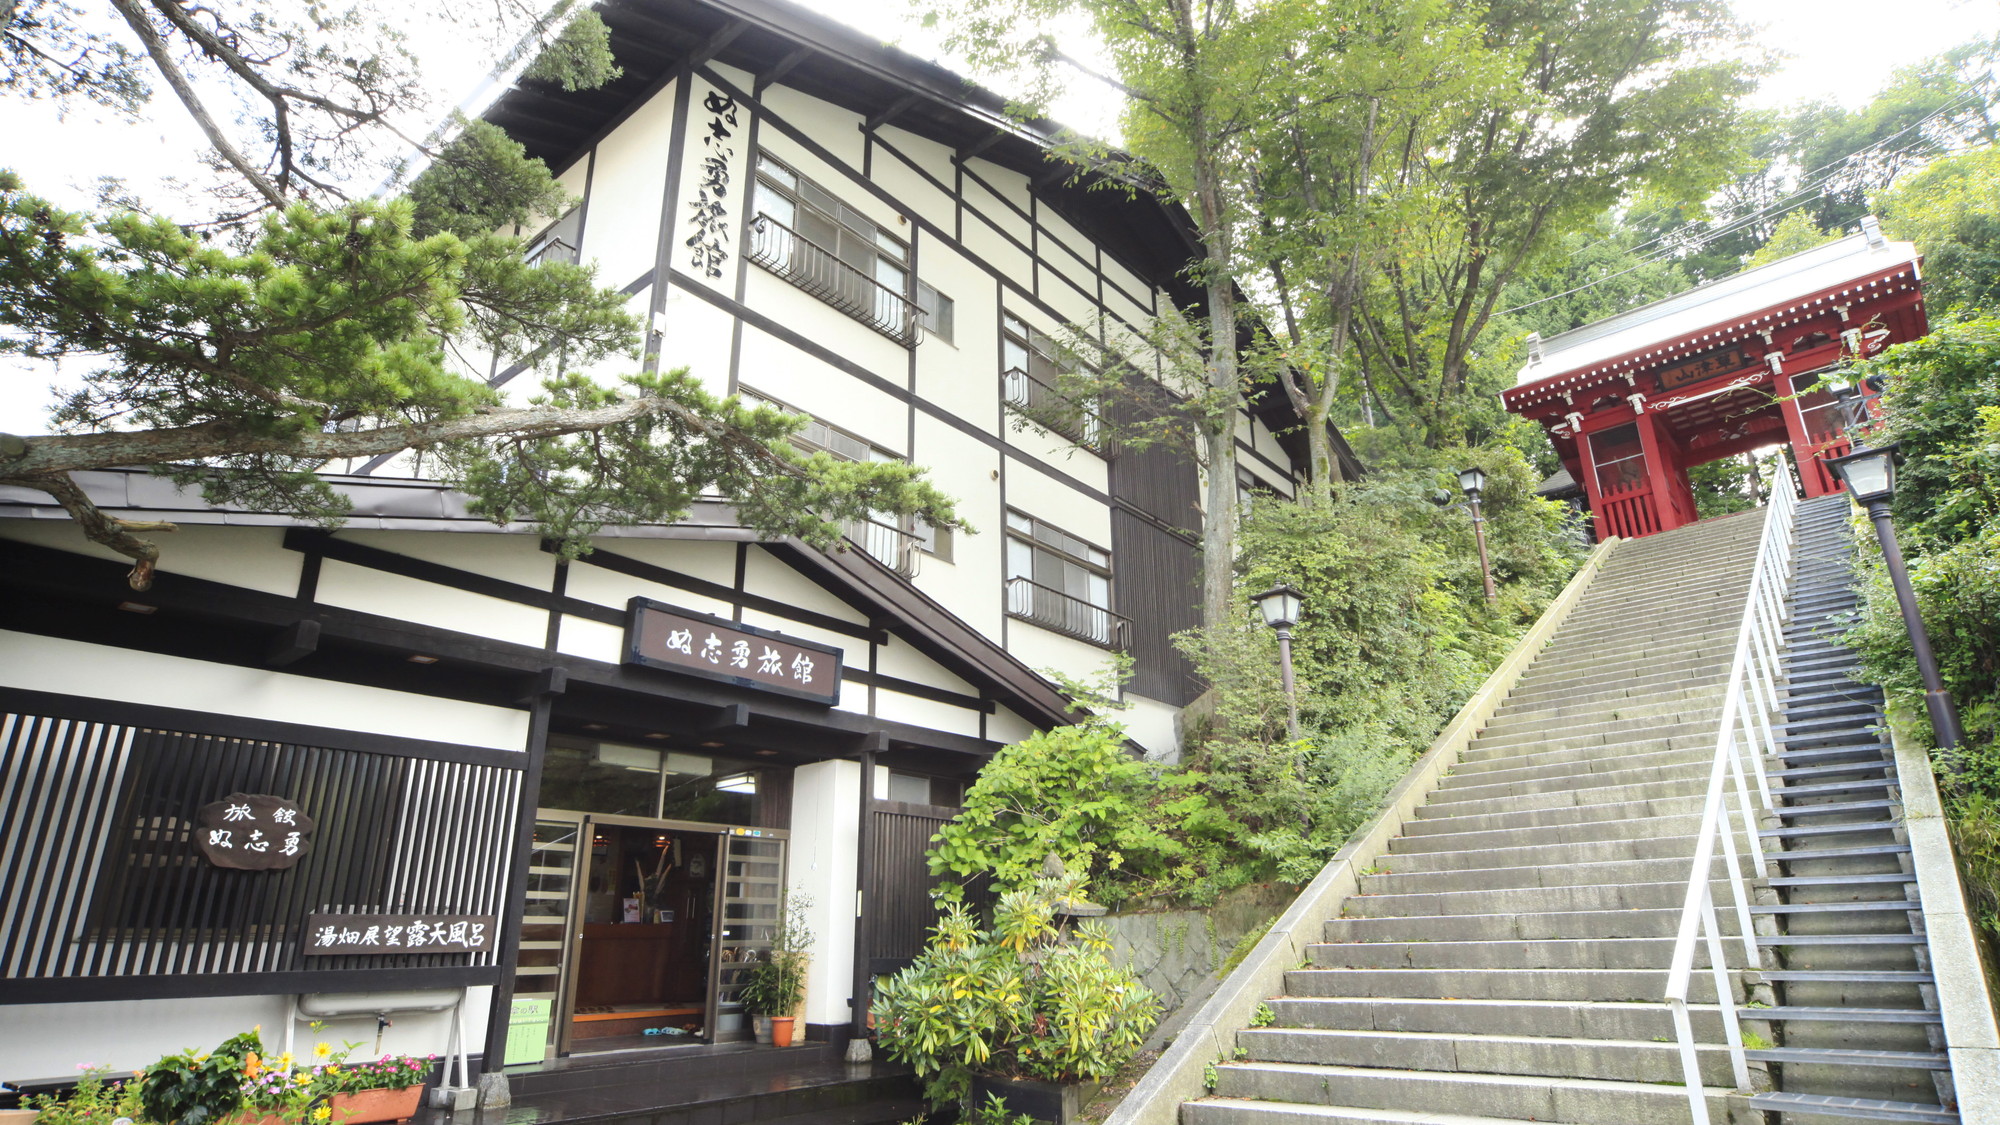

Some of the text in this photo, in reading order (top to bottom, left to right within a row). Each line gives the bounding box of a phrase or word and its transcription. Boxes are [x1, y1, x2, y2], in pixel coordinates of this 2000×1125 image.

[667, 628, 815, 685] ぬ志勇旅館
[314, 920, 486, 949] 湯畑展望露天風呂
